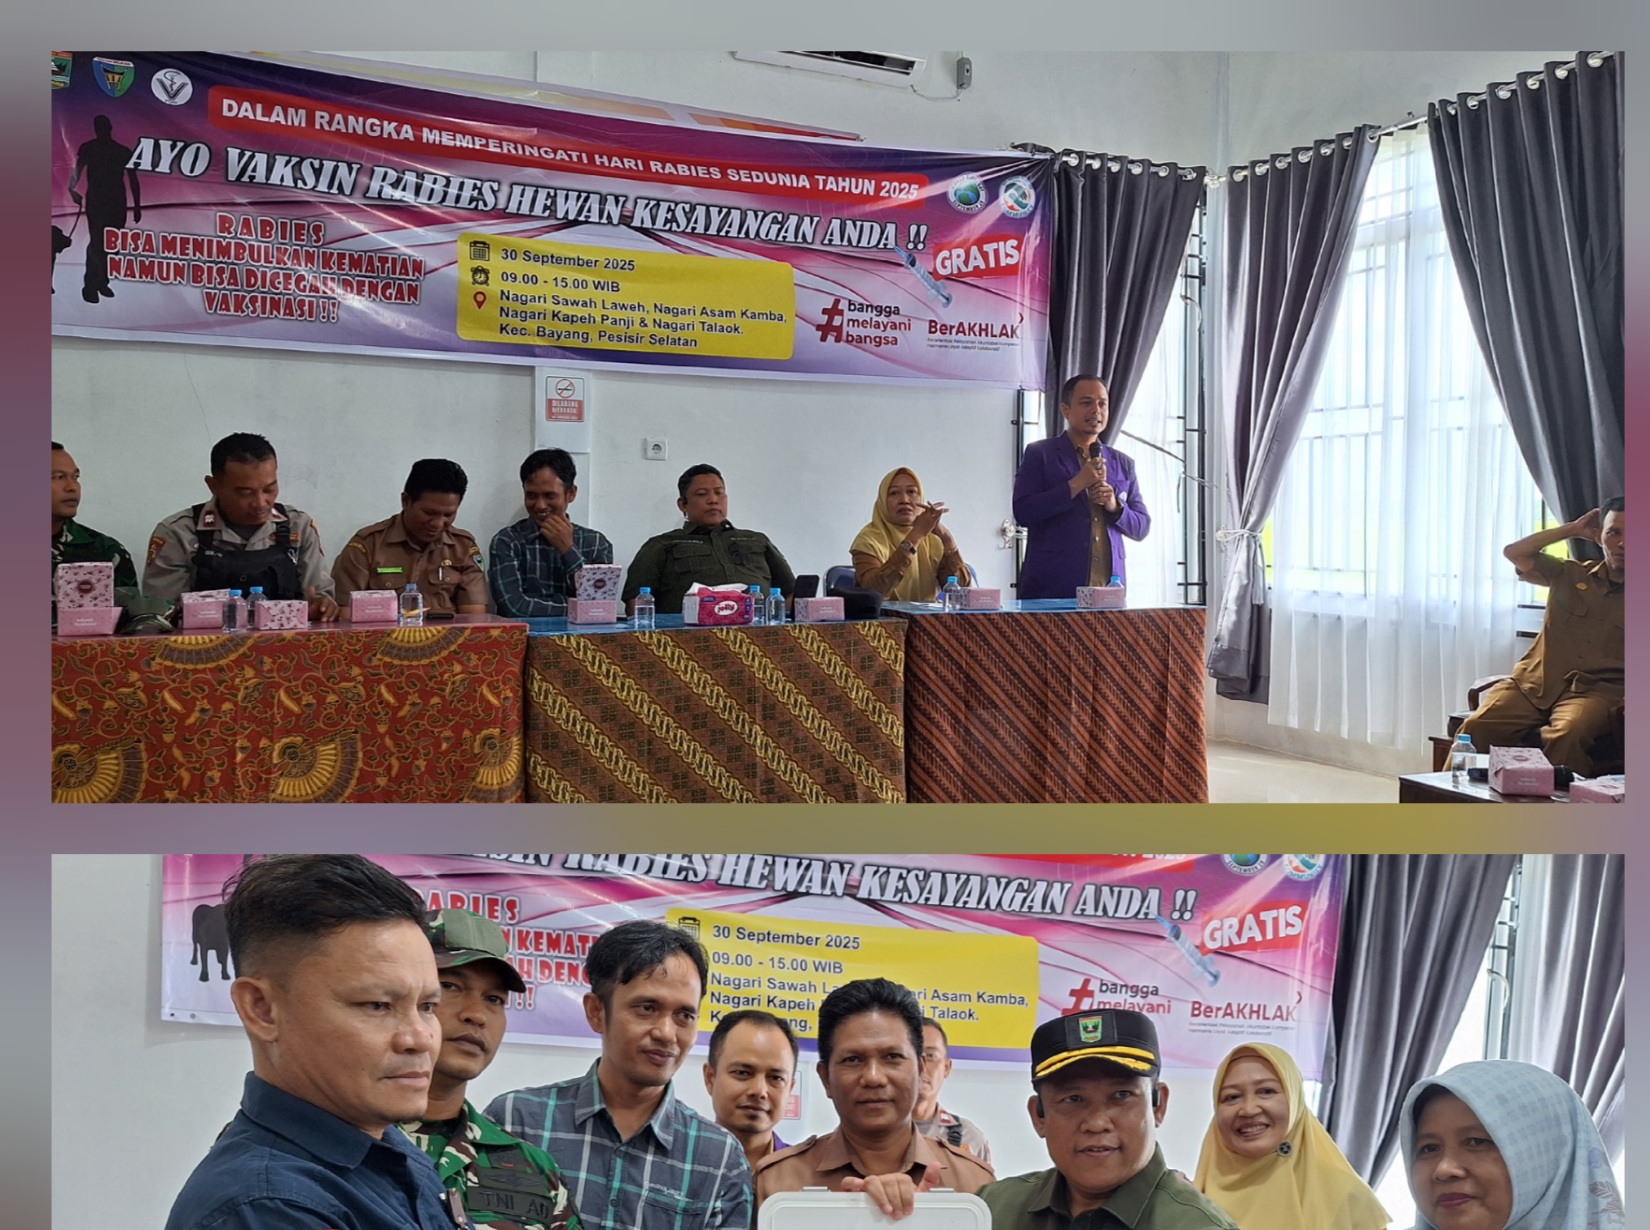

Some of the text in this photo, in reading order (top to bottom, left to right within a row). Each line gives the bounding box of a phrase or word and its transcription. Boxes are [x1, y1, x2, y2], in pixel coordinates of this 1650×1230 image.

[222, 99, 919, 200] DALAM RANGKA MEMPERINGATI HARI RABIES SEDUNIA TAHUN 2025
[126, 137, 210, 177] AYO
[226, 147, 360, 195] VAKSIN
[365, 166, 499, 211] RABIES
[505, 184, 627, 226] HEWAN
[631, 197, 819, 244] KESAYANGAN
[823, 218, 897, 249] ANDA
[217, 212, 324, 246] RABIES
[104, 227, 425, 279] BISA MENIMBULKAN KEMATIAN
[501, 248, 635, 271] 30 September 2025
[936, 239, 1020, 276] GRATIS
[107, 255, 420, 304] NAMUN BISA DICEGAH DENGAN
[501, 272, 620, 292] 09.00 15.00 WIB
[203, 290, 315, 320] VAKSINASI
[500, 290, 787, 323] Nagari Sawah Laweh, Nagari Asam Kamba,
[848, 300, 900, 317] bangga
[500, 307, 744, 335] Nagari Kapeh Panji & Nagari Talaok.
[847, 316, 911, 333] melayani
[928, 319, 1020, 339] BerAKHLAK
[500, 323, 697, 348] Kec. Bayang, Pesisir Selatan
[845, 331, 898, 347] bangsa
[718, 854, 1160, 920] HEWAN KESAYANGAN ANDA
[712, 925, 860, 950] 30 September 2025
[1204, 905, 1302, 949] GRATIS
[931, 989, 1029, 1009] Asam Kamba,
[1190, 1000, 1297, 1022] BerAKHLAK
[480, 1191, 514, 1209] TNI
